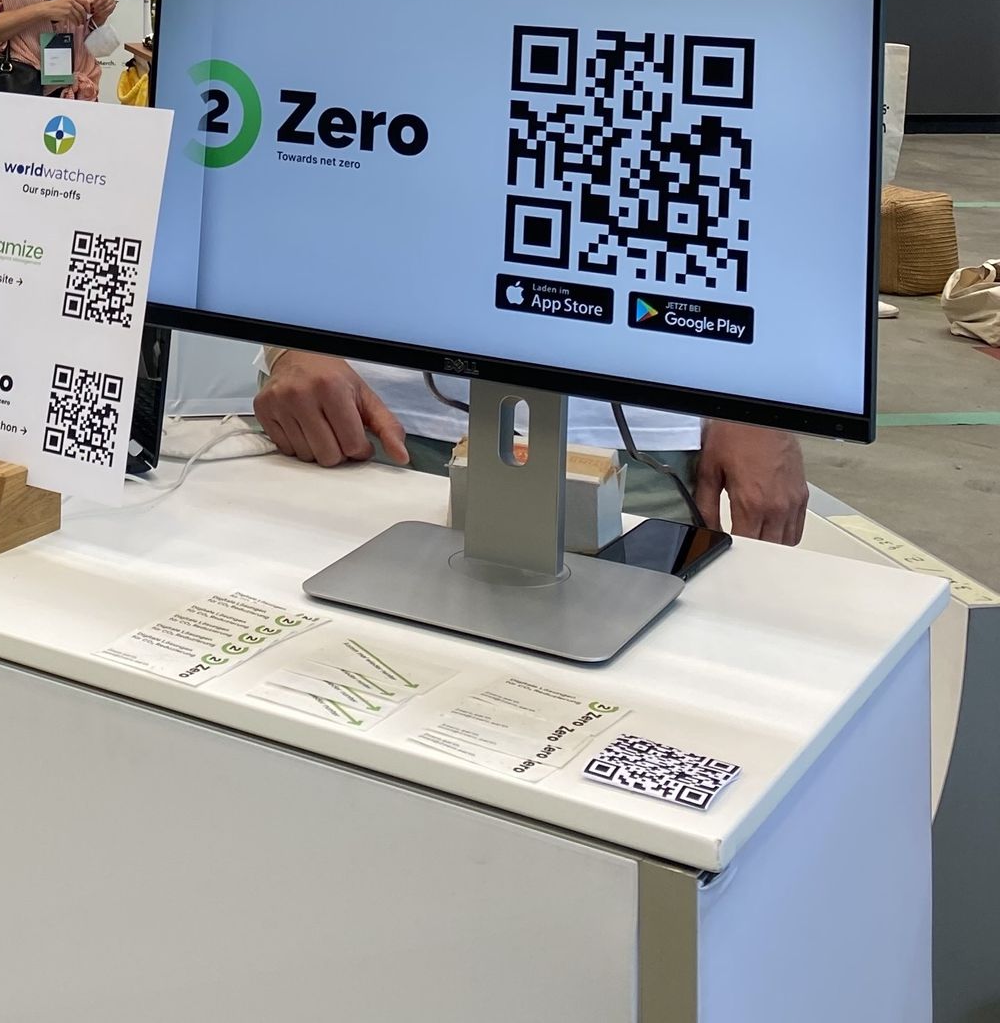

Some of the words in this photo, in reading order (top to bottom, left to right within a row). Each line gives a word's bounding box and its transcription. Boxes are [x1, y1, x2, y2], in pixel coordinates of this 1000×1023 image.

[198, 89, 229, 134] 2
[277, 89, 428, 156] Zero
[277, 151, 317, 164] Towards
[320, 157, 336, 167] net
[338, 158, 361, 169] zero
[4, 161, 106, 186] worldwatchers
[22, 184, 38, 194] Our
[40, 186, 81, 200] spin-offs
[532, 283, 557, 293] Laden
[559, 286, 570, 295] im
[531, 294, 561, 314] App
[564, 298, 603, 316] Store
[665, 302, 687, 311] JETZT
[689, 304, 701, 312] BEI
[665, 311, 714, 333] Google
[717, 318, 746, 338] Play
[178, 663, 210, 678] Zero
[572, 711, 602, 727] Zero
[547, 725, 575, 742] Zero
